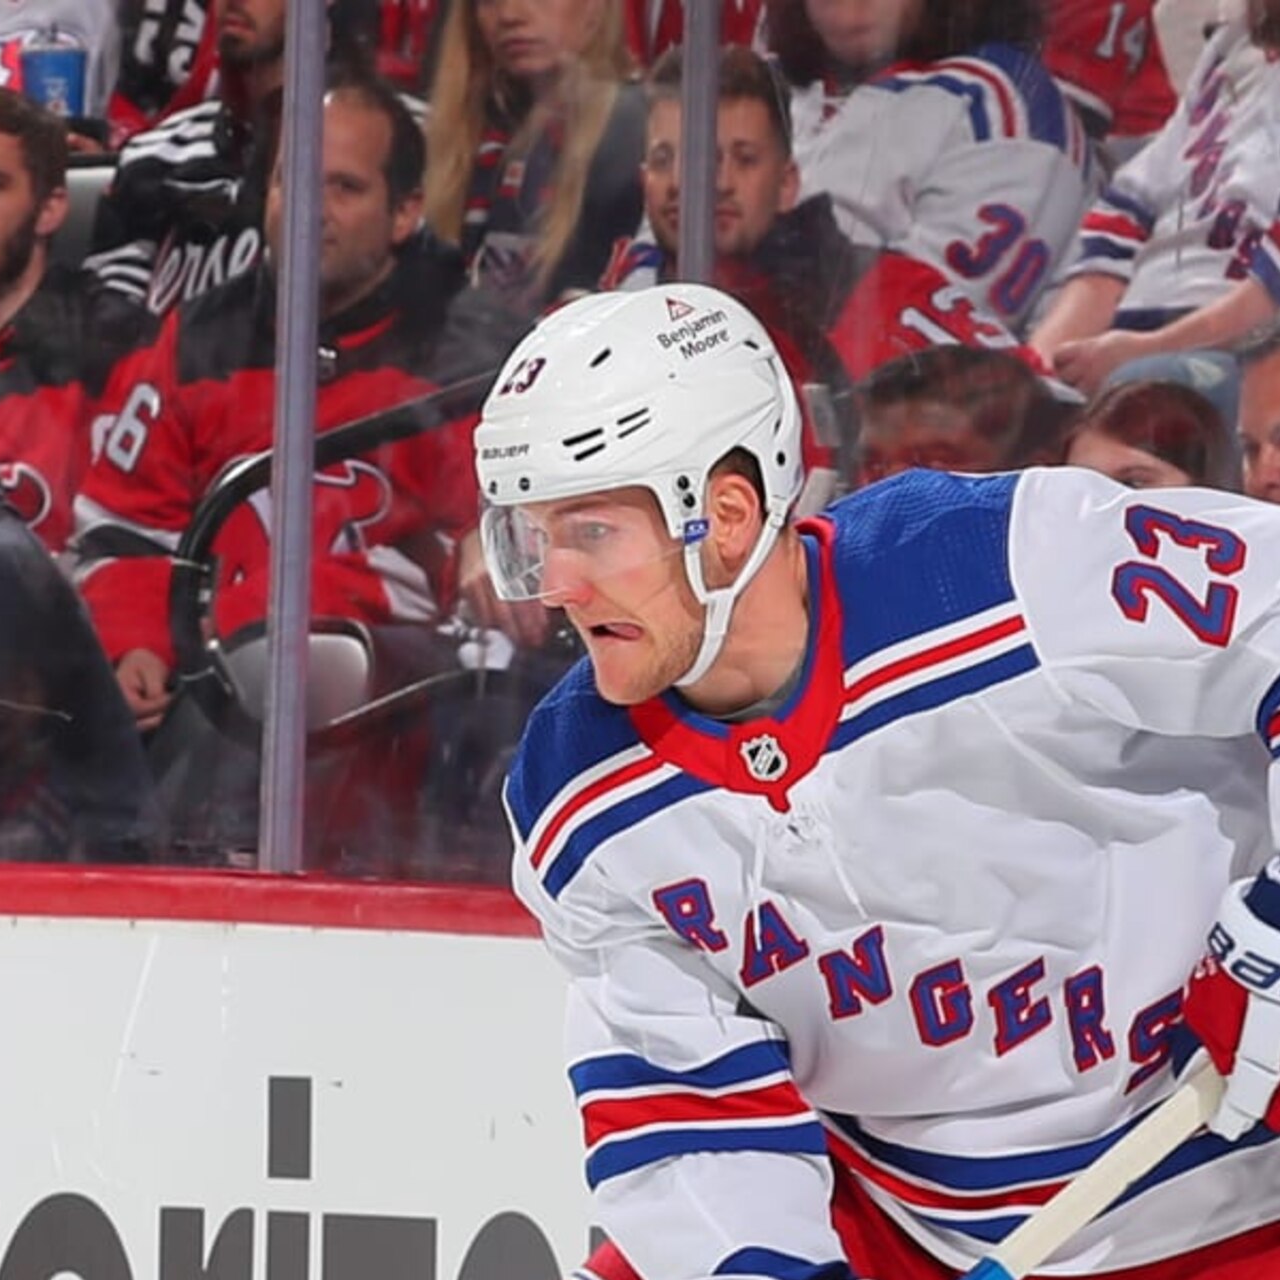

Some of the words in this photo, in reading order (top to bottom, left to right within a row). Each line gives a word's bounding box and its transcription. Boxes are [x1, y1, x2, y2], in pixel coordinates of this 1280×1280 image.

[945, 203, 1050, 317] 30
[657, 309, 728, 349] Benjamin
[679, 327, 731, 360] Moore
[481, 443, 530, 460] BAUER
[1111, 504, 1247, 648] 23
[652, 877, 1186, 1096] RANGERS
